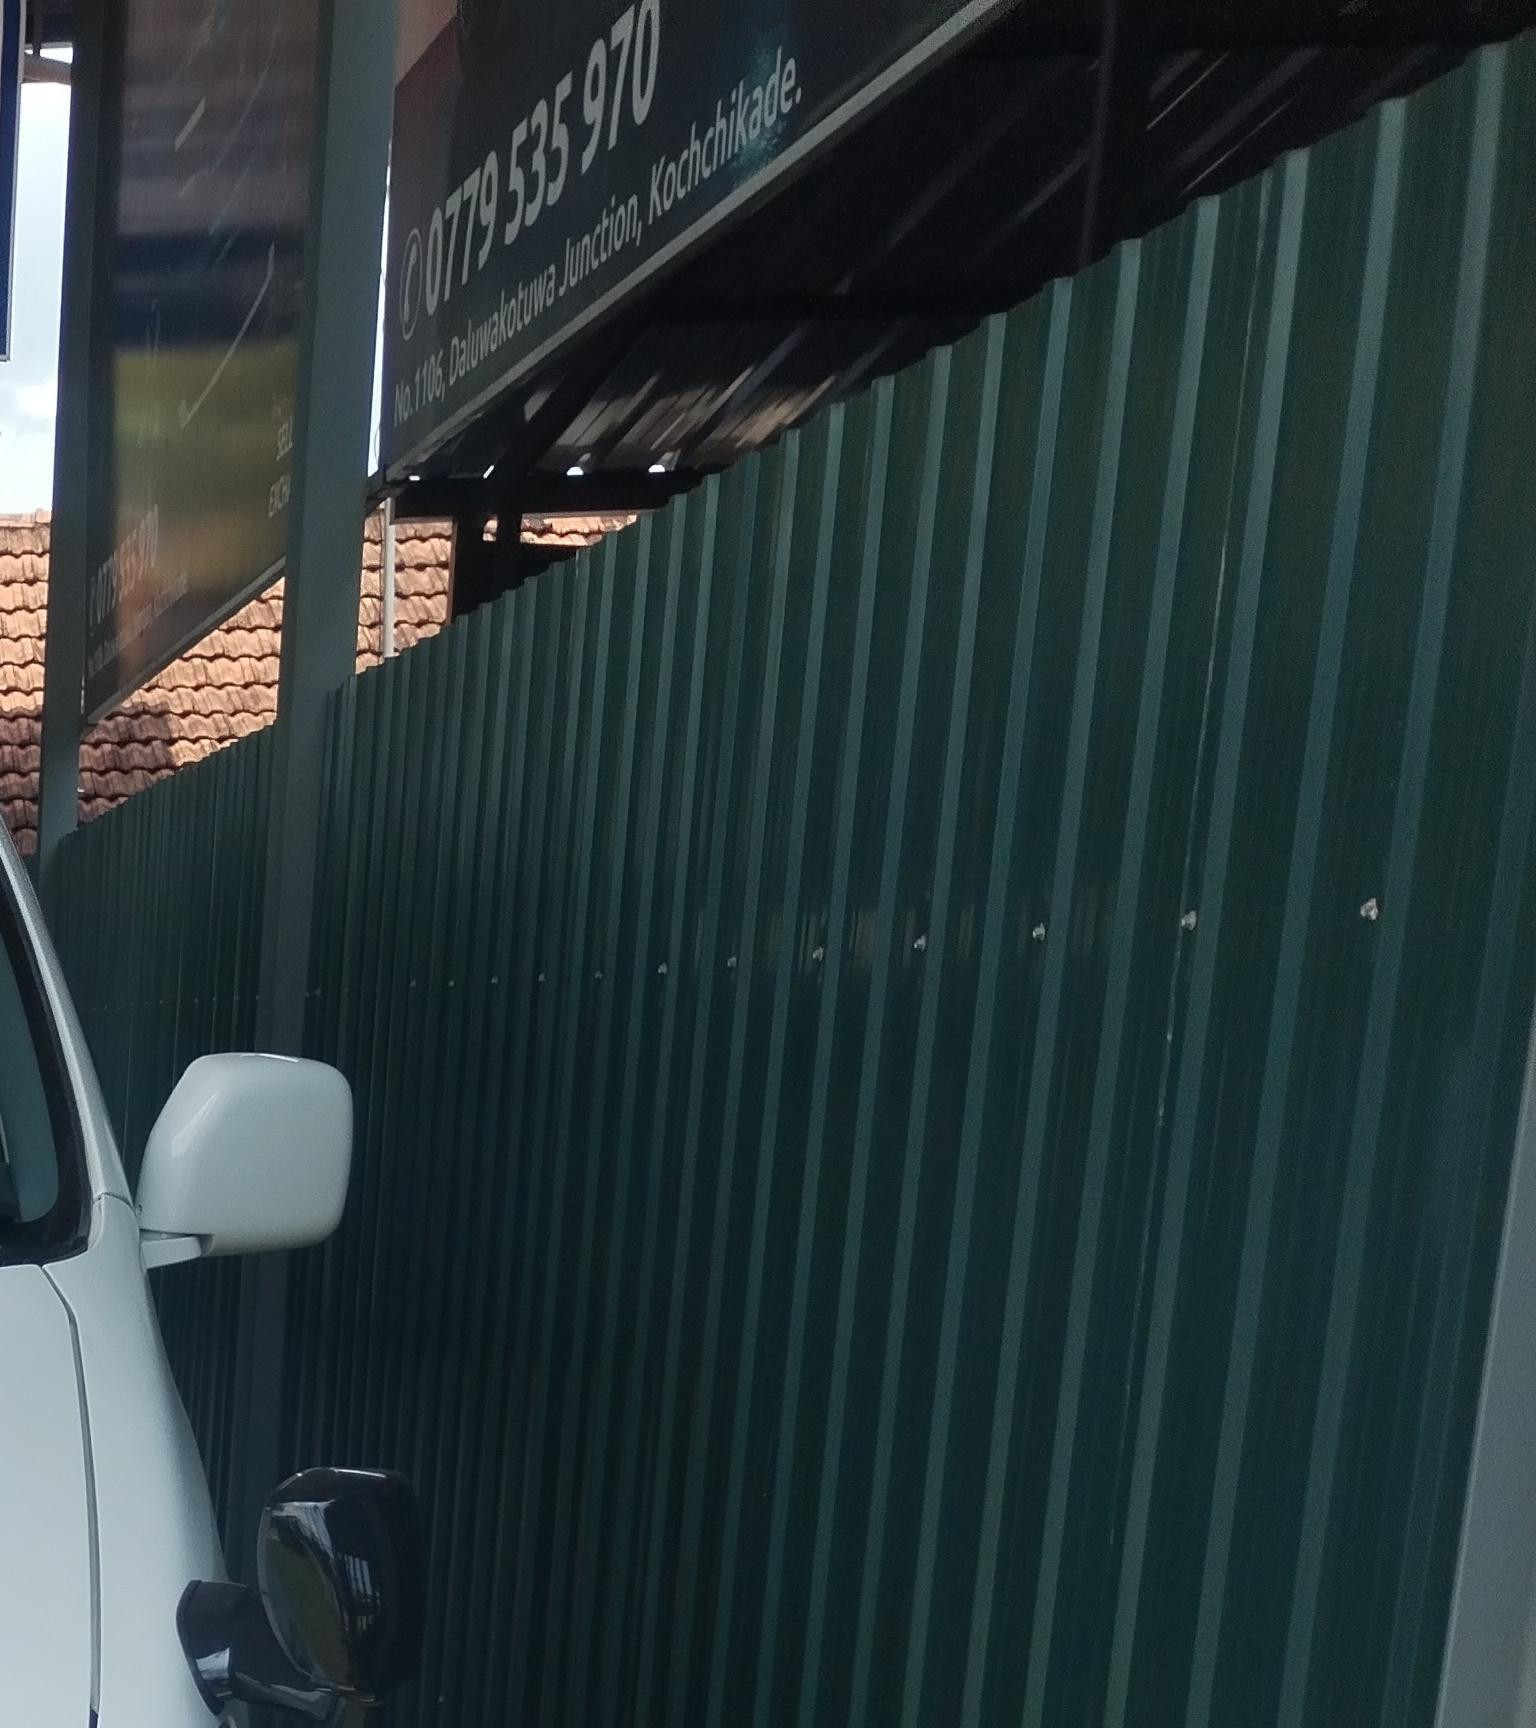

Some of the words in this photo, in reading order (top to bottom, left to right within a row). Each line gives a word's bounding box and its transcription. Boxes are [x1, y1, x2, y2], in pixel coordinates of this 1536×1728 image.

[394, 381, 414, 427] No.
[414, 349, 446, 404] 1106,
[449, 263, 556, 387] Daluwakotuwa
[558, 194, 642, 297] Junction,
[648, 46, 802, 226] Kochchikade.
[425, 150, 499, 316] 0779
[504, 70, 570, 246] 535
[581, 0, 660, 176] 970
